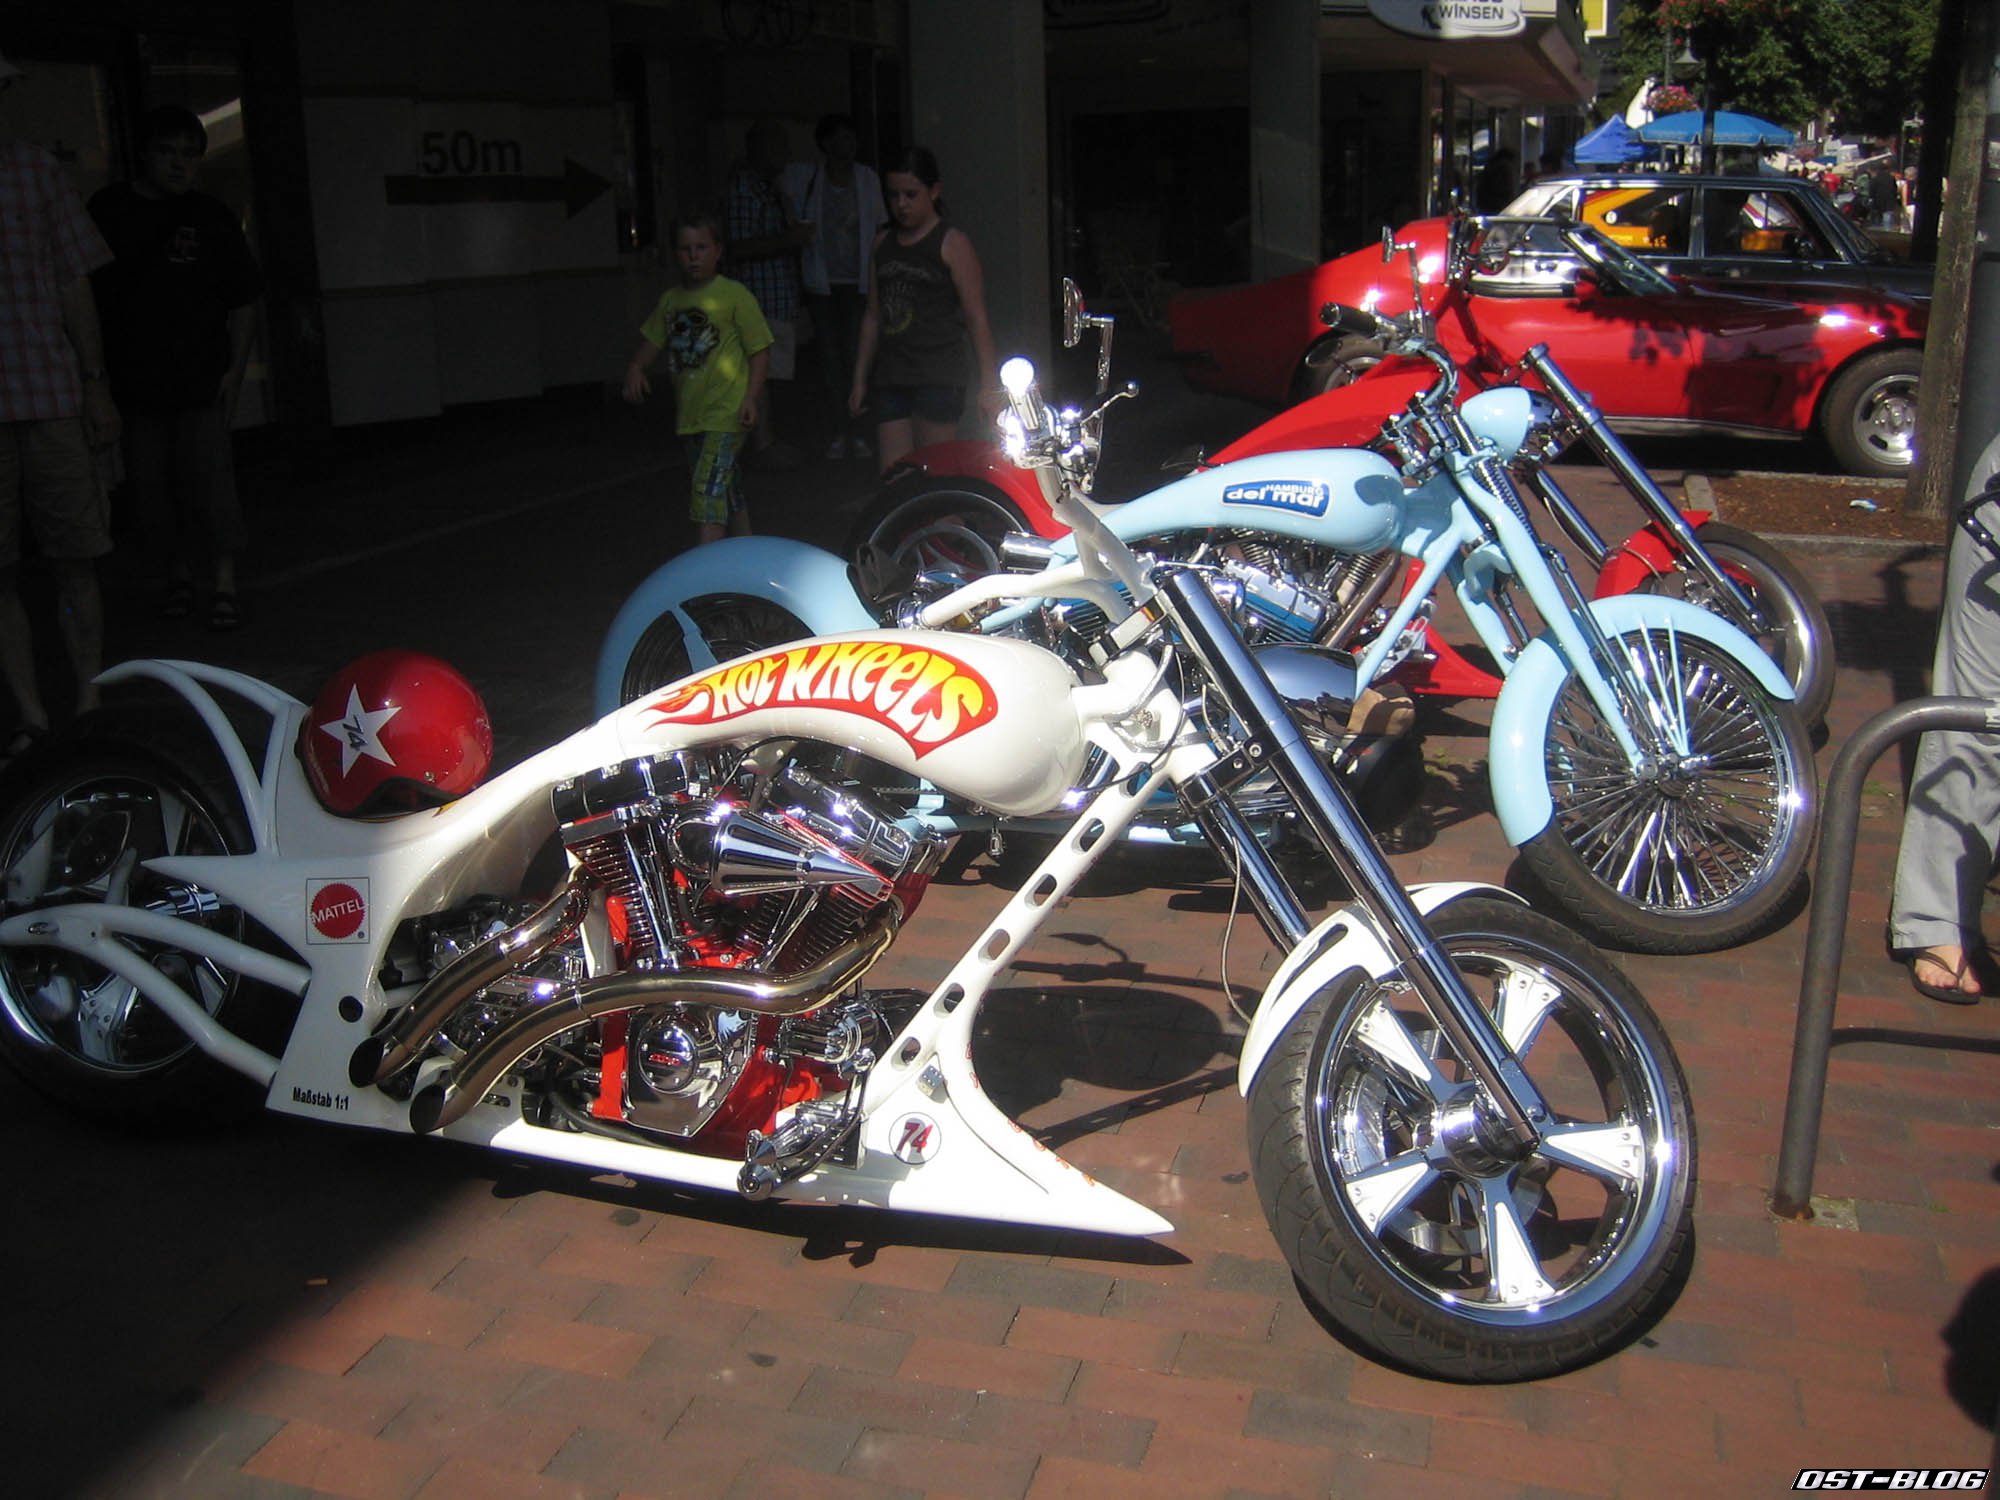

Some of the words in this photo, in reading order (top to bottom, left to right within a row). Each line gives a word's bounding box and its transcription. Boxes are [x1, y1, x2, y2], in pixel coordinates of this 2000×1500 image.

[1439, 5, 1504, 20] WINSEN
[419, 130, 522, 174] 50m
[1226, 487, 1266, 501] del
[1271, 490, 1325, 508] mar
[1265, 484, 1325, 497] HAMBURG
[309, 898, 370, 924] MATTEL
[293, 1086, 332, 1108] Maßstab
[335, 1094, 349, 1111] 1:1
[896, 1122, 934, 1154] 74
